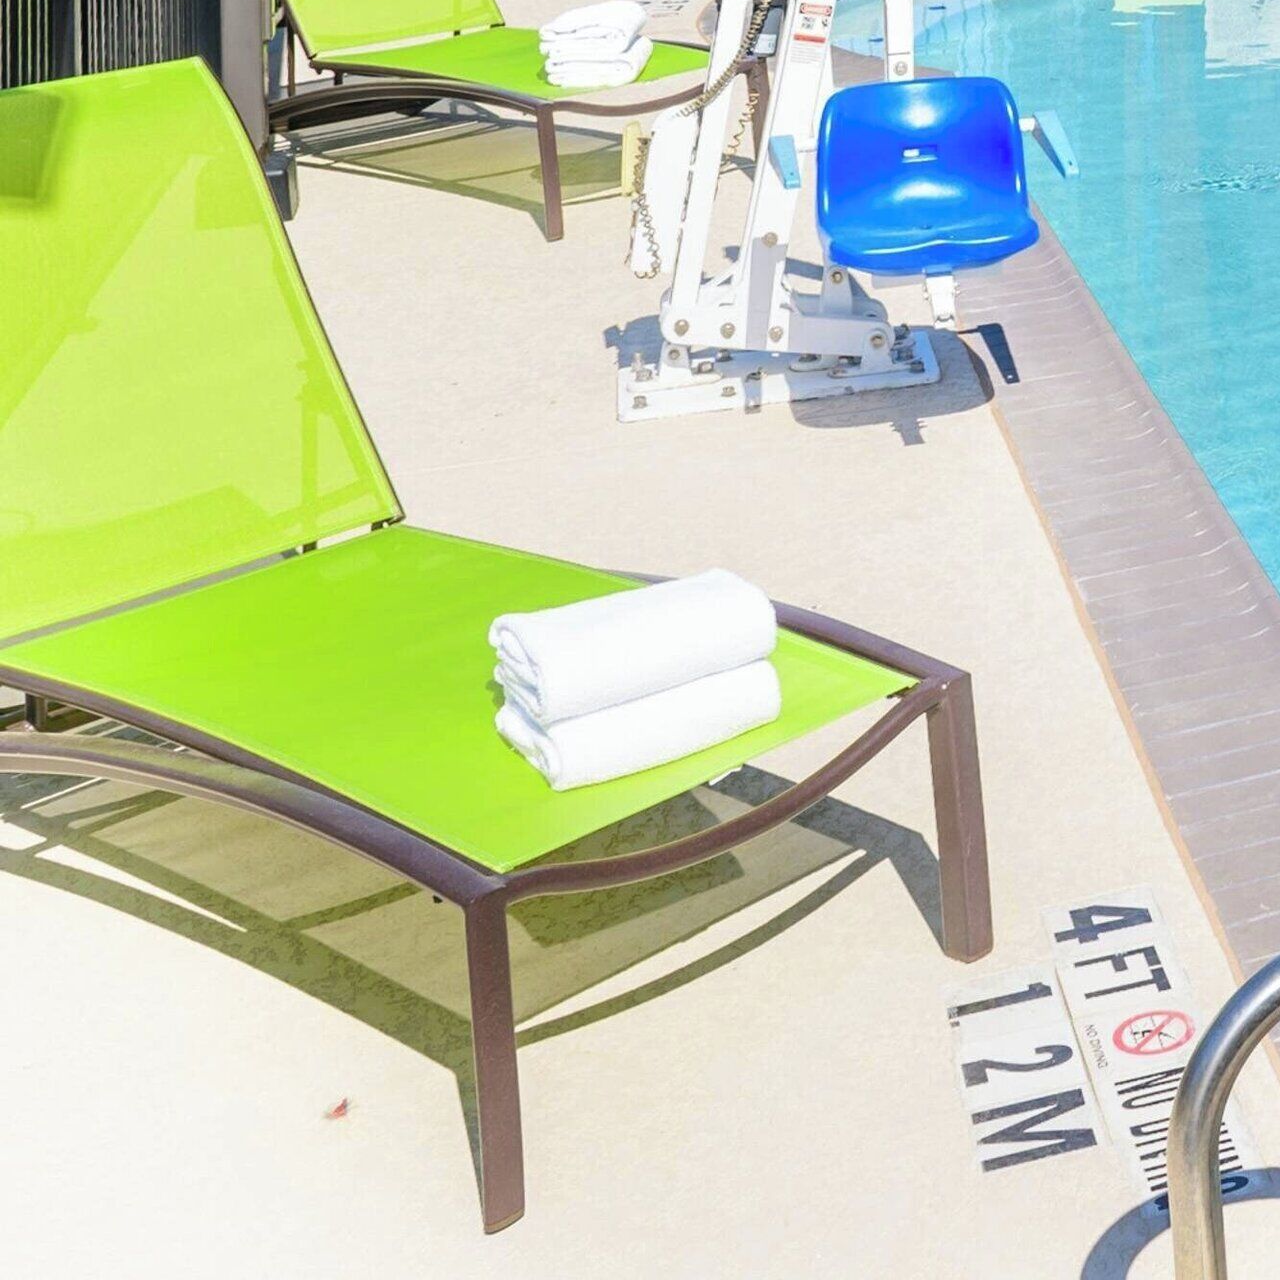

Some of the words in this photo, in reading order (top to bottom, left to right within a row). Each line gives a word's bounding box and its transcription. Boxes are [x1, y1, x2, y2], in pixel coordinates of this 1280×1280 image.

[1054, 905, 1153, 944] 4
[1074, 945, 1172, 1000] FT
[1088, 1038, 1109, 1070] DIVING
[971, 1088, 1099, 1173] M
